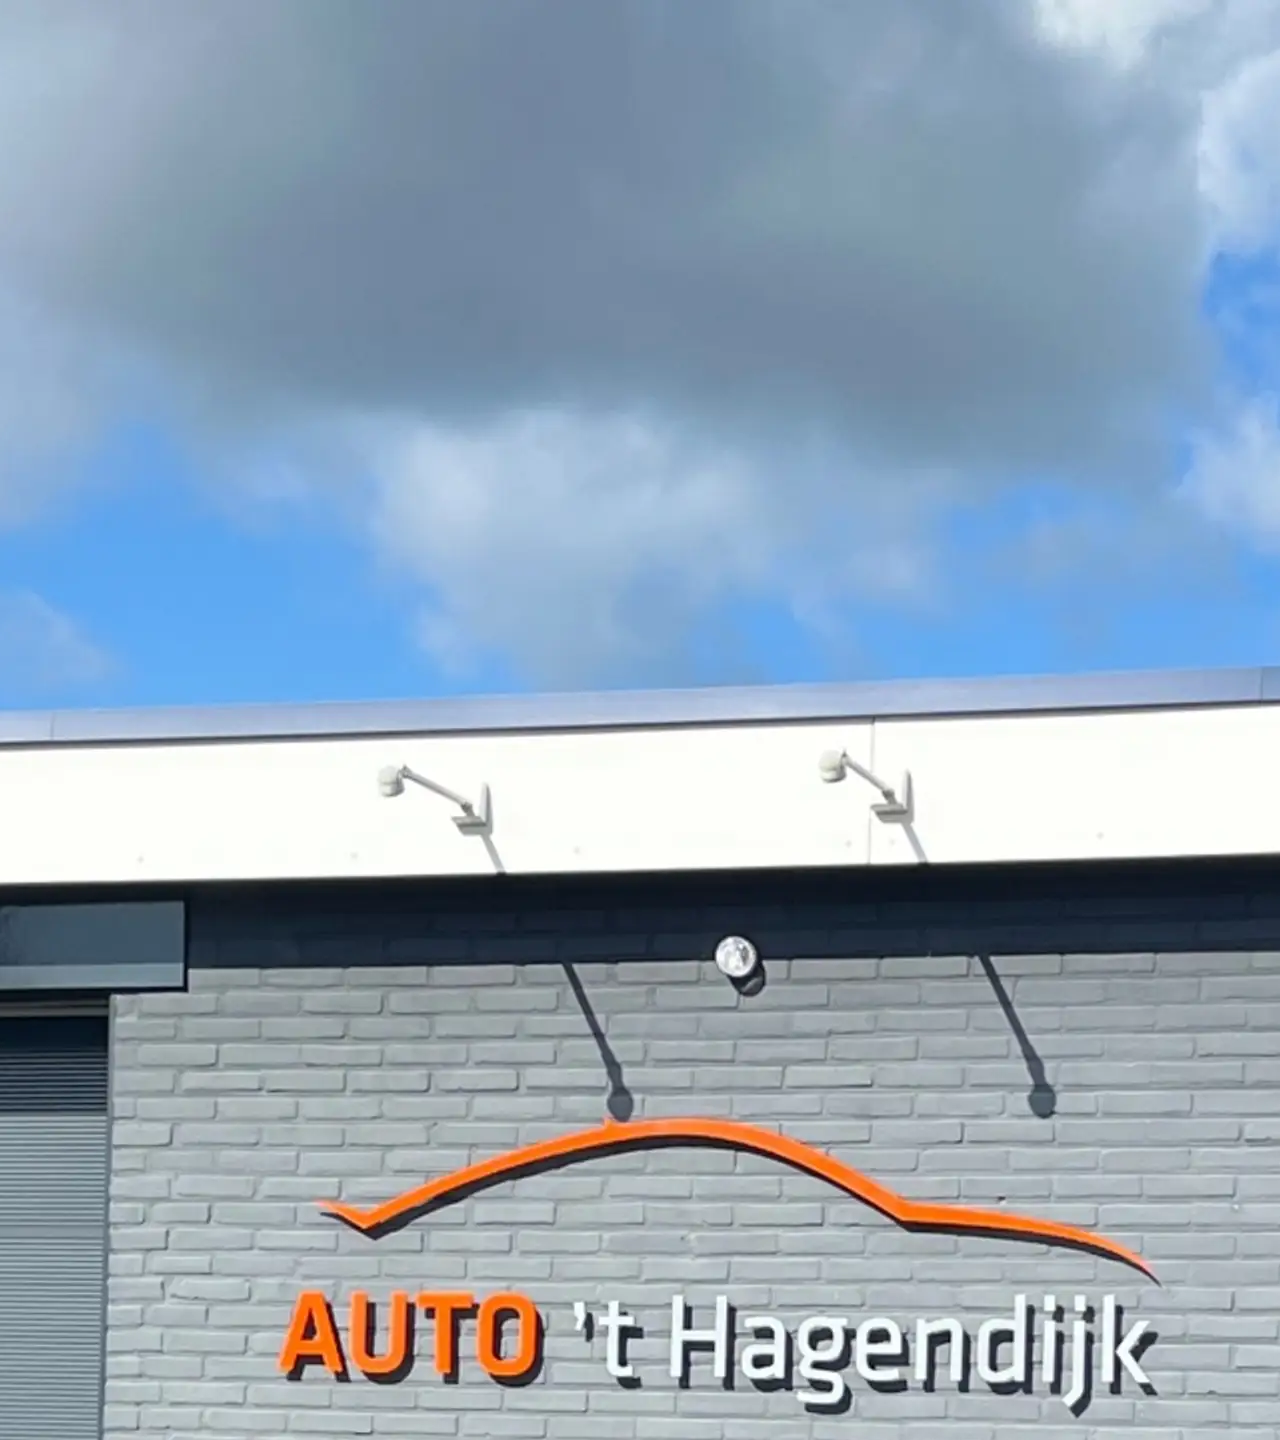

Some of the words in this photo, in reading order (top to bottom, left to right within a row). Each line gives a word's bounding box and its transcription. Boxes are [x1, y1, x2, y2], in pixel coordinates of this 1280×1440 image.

[278, 1291, 538, 1378] AUTO
[573, 1299, 636, 1378] 't
[670, 1293, 1154, 1409] Hagendijk
